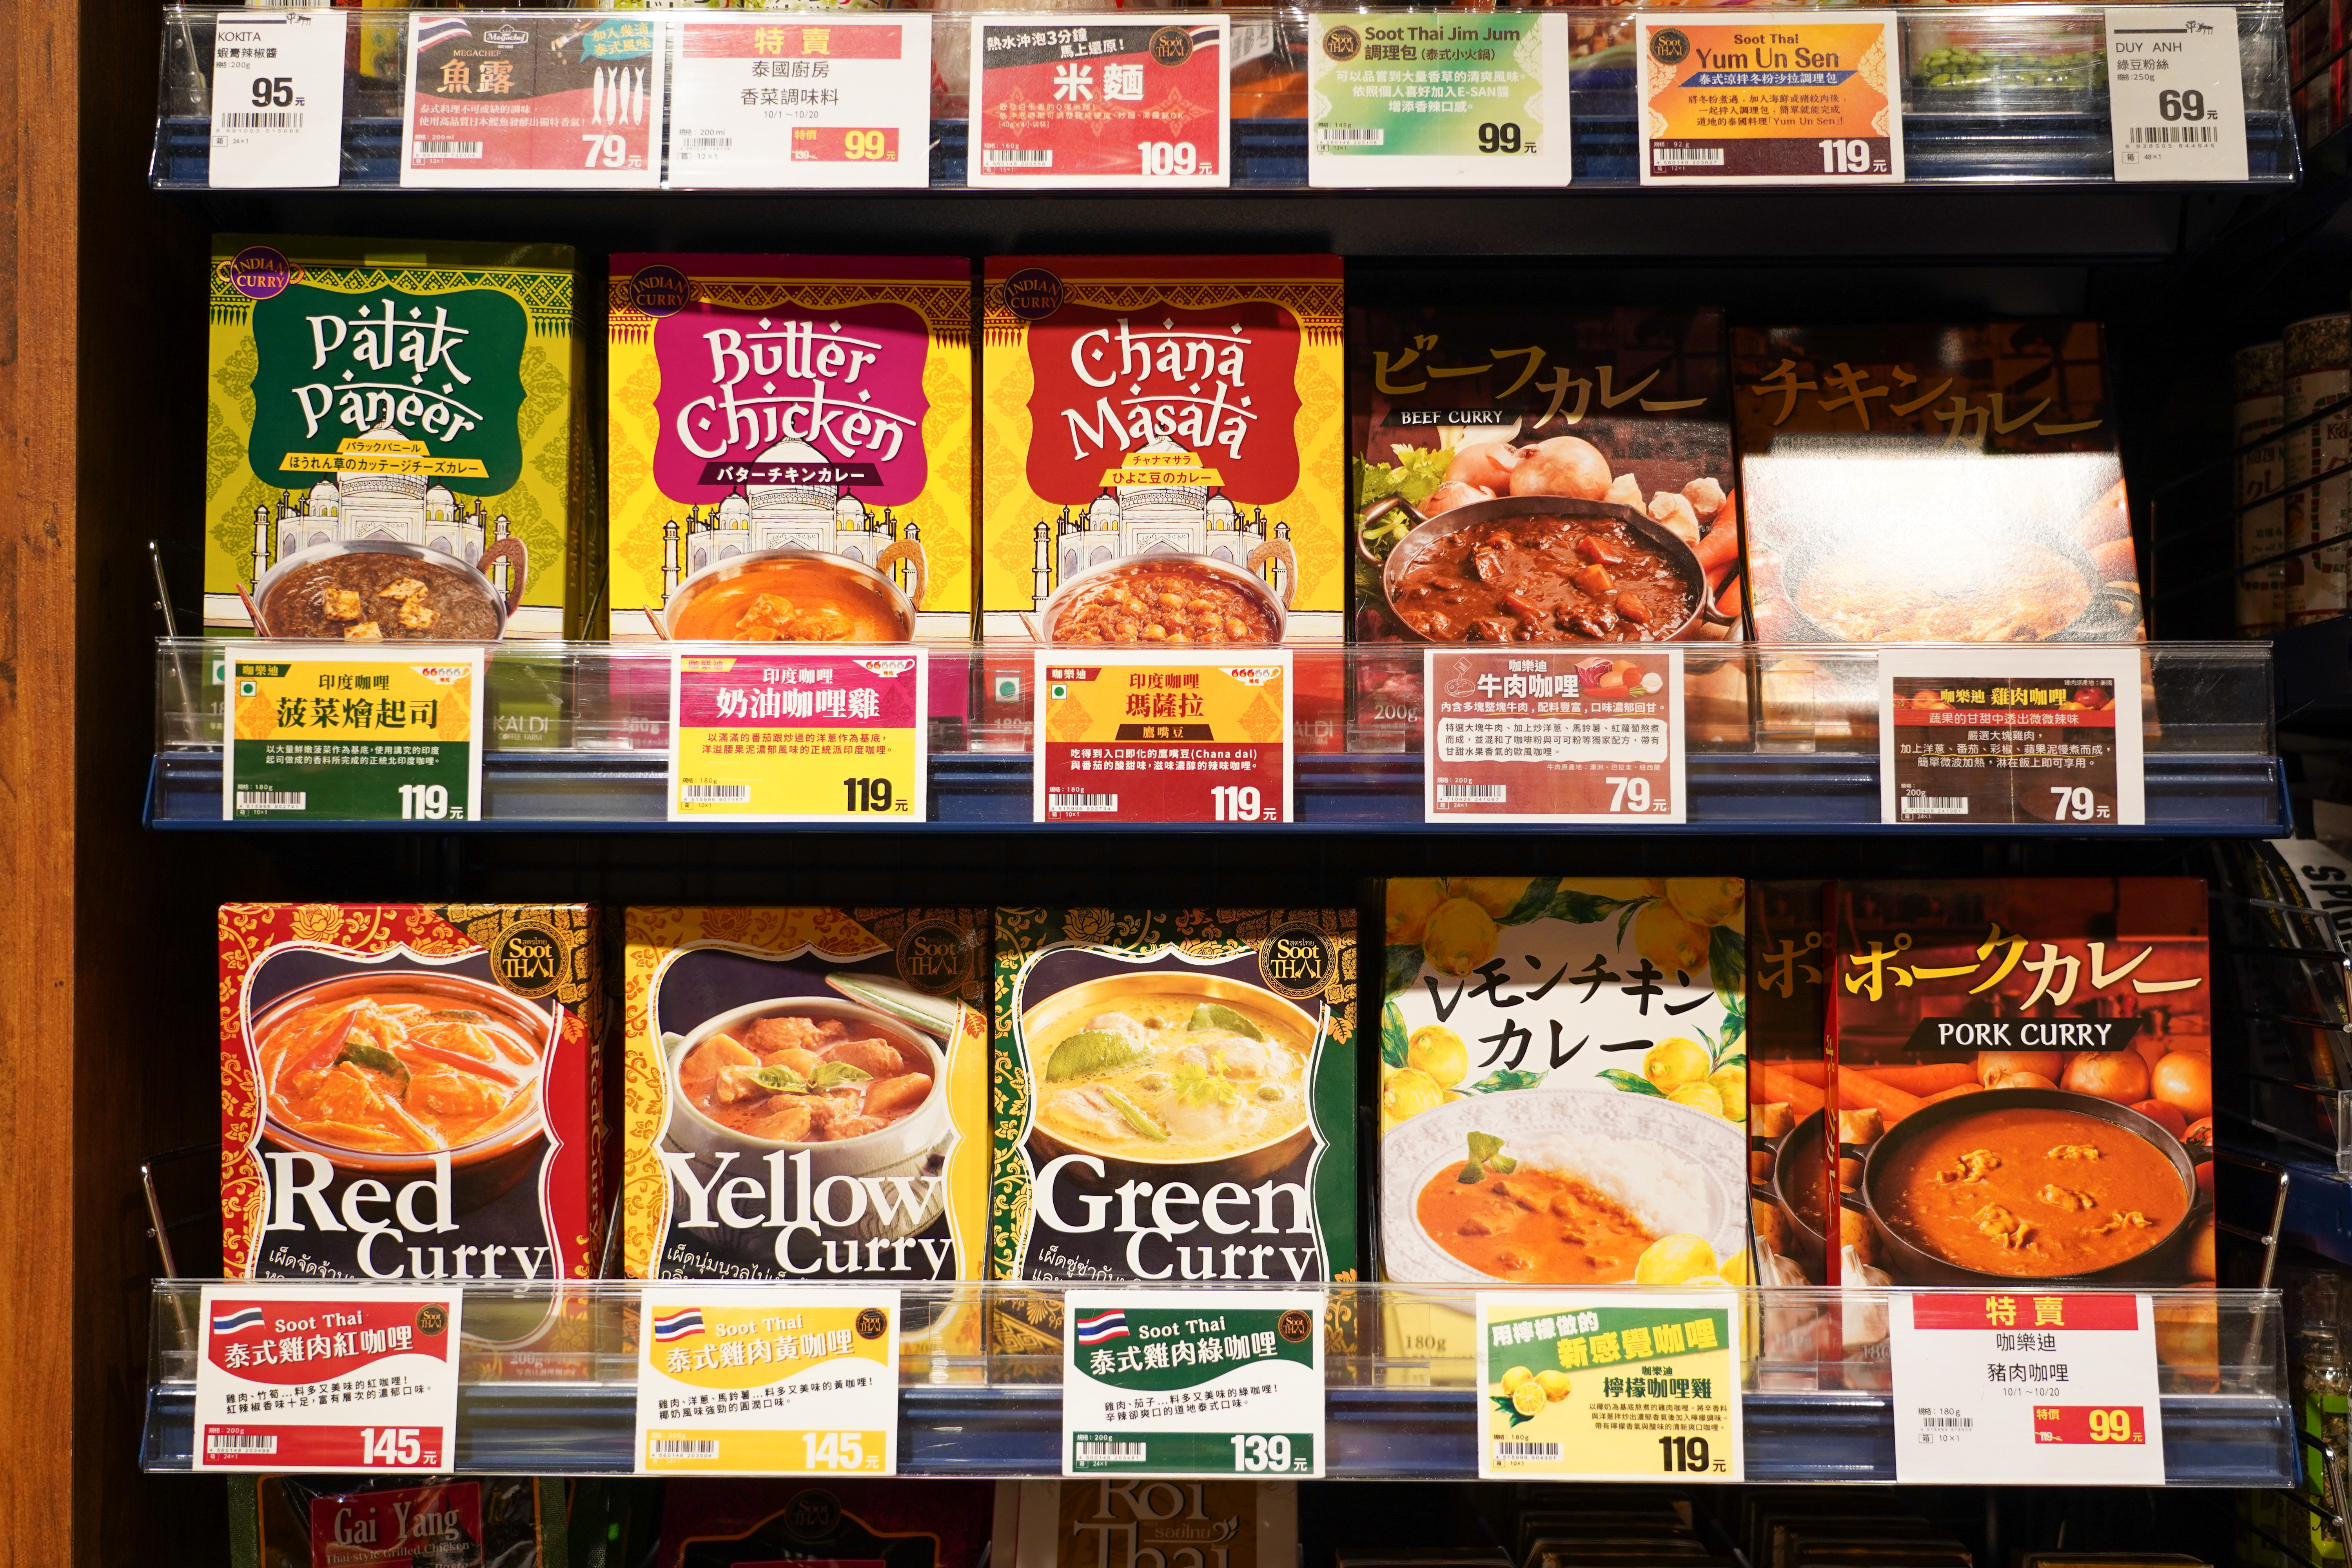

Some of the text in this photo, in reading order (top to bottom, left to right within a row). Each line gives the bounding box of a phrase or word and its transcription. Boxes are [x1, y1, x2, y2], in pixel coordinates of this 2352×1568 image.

[218, 32, 261, 42] KOKITA
[486, 32, 526, 42] Megachef
[987, 28, 1088, 51] 熱水沖泡3分鐘
[1365, 27, 1520, 41] Soot Thai Jim Jum
[1734, 34, 1799, 45] Soot Thai
[217, 48, 278, 58] 蝦膏辣椒醬
[593, 37, 651, 56] 泰式風味
[1365, 45, 1417, 61] 調理包
[2116, 42, 2182, 53] DUY ANH
[1696, 47, 1839, 69] Yum Un Sen
[2117, 59, 2169, 70] 綠豆粉絲
[437, 59, 515, 94] 魚露
[752, 61, 829, 78] 泰國廚房
[1699, 72, 1838, 85] 泰式涼拌冬粉沙拉調理包
[1053, 63, 1144, 102] 米麵
[740, 88, 839, 106] 香菜調味料
[794, 130, 817, 140] 特價
[233, 258, 289, 278] INDIAN
[236, 275, 285, 289] CURRY
[632, 277, 689, 296] INDIAN
[636, 292, 685, 307] CURRY
[306, 298, 471, 385] Palak
[703, 317, 882, 384] Butter
[1071, 318, 1251, 387] Chana
[292, 369, 483, 442] Paneer
[677, 378, 916, 462] Chicken
[1061, 380, 1257, 461] Masala
[1401, 410, 1502, 425] BEEF CURRY
[346, 441, 421, 453] パラックパニール
[289, 457, 478, 474] ほうれん草のカッテージチーズカレー
[1132, 455, 1191, 465] チャナマサラ
[717, 467, 864, 483] バターチキンカレー
[1112, 471, 1212, 484] ひよこ豆のカレー
[243, 665, 278, 676] 咖樂迪
[688, 660, 723, 671] 咖樂迪
[1052, 669, 1086, 679] 咖樂迪
[1509, 660, 1547, 672] 咖樂迪
[319, 674, 390, 690] 印度咖哩
[763, 668, 834, 684] 印度咖哩
[1130, 673, 1200, 690] 印度咖哩
[1477, 673, 1579, 699] 牛肉咖哩
[716, 687, 880, 719] 奶油咖哩雞
[1125, 693, 1204, 718] 瑪薩拉
[1940, 688, 2067, 706] 咖樂迪 雞肉咖哩
[276, 697, 439, 730] 菠菜燴起司
[1374, 705, 1418, 722] 200g
[1929, 713, 2079, 725] 蔬果的甘甜中透出微微辣味
[494, 716, 548, 733] KALDI
[1142, 726, 1184, 739] 鷹嘴豆
[1906, 788, 1926, 797] 200g
[509, 937, 552, 959] Soot
[914, 936, 956, 957] Soot
[1277, 937, 1320, 959] Soot
[502, 957, 555, 978] THAI
[907, 956, 959, 976] THAI
[1270, 958, 1323, 979] THAI
[1423, 954, 1715, 1022] レモンチキン
[1477, 1018, 1654, 1071] カレー
[1938, 1023, 2112, 1047] PORK CURRY
[265, 1151, 459, 1234] Red
[658, 1149, 945, 1229] Yellow
[1035, 1153, 1312, 1234] Green
[357, 1228, 549, 1291] Curry
[775, 1222, 955, 1282] Curry
[1126, 1227, 1318, 1282] Curry
[275, 1310, 363, 1333] Soot Thai
[716, 1314, 803, 1337] Soot Thai
[1139, 1316, 1226, 1339] Soot Thai
[1492, 1310, 1599, 1347] 用檸檬做的
[225, 1325, 414, 1369] 泰式雞肉紅咖哩
[666, 1329, 855, 1373] 泰式雞肉黃咖哩
[1557, 1318, 1718, 1369] 新感覺咖哩
[1996, 1333, 2056, 1352] 咖樂迪
[1090, 1330, 1278, 1376] 泰式雞肉綠咖哩
[1641, 1366, 1673, 1376] 咖樂迪
[1987, 1363, 2069, 1382] 豬肉咖哩
[1603, 1377, 1713, 1399] 檸檬咖哩雞
[2036, 1409, 2060, 1420] 特價
[334, 1500, 459, 1545] Gai Yang
[326, 1541, 470, 1564] Thai-style Grilled Chicken
